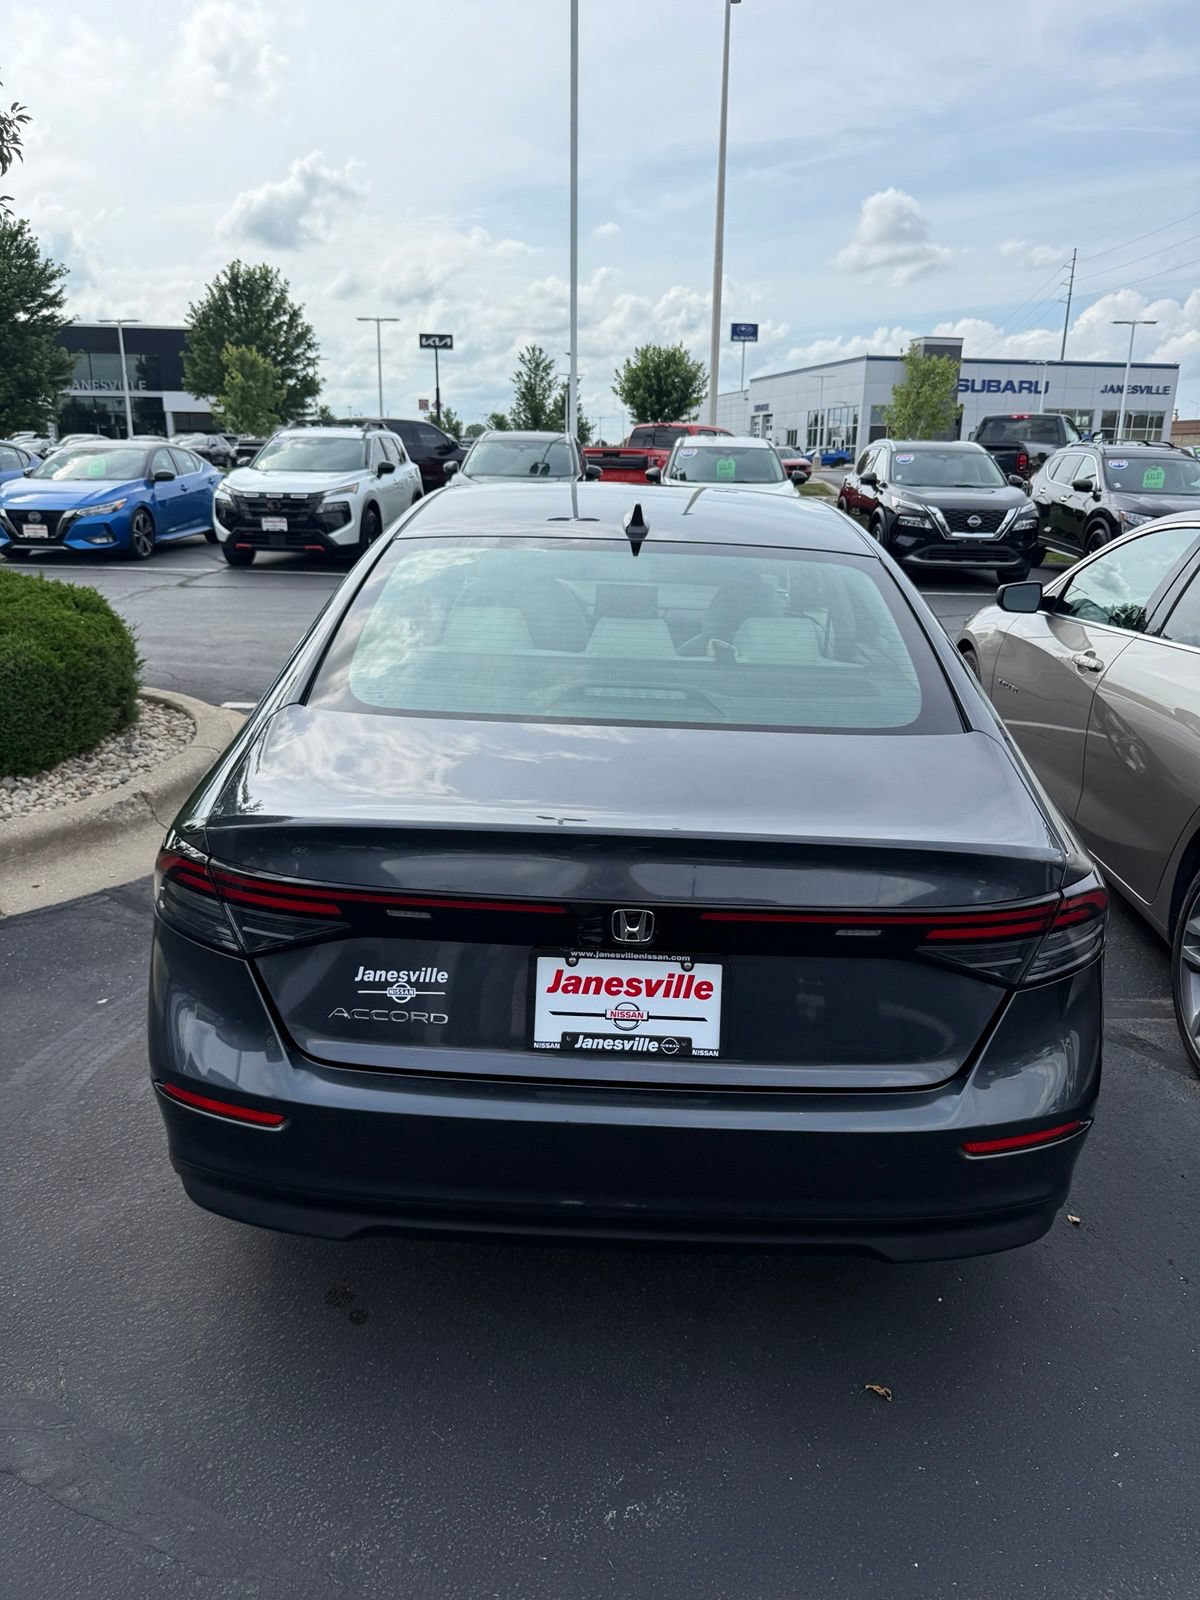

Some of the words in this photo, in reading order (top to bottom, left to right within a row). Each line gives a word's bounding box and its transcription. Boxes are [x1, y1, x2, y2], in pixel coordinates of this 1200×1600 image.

[421, 337, 452, 346] KIA
[957, 378, 1050, 394] SUBARU
[1100, 384, 1172, 396] JANESVILLE
[571, 950, 691, 962] www.janesvillenissan.com
[354, 966, 449, 984] Janesville
[546, 969, 714, 1001] Janesville
[389, 989, 416, 997] NISSAN
[328, 1008, 449, 1025] ACCORD
[610, 1010, 644, 1019] NISSAN
[533, 1041, 560, 1050] NISSAN
[574, 1033, 659, 1051] Janesville
[692, 1048, 719, 1057] NISSAN
